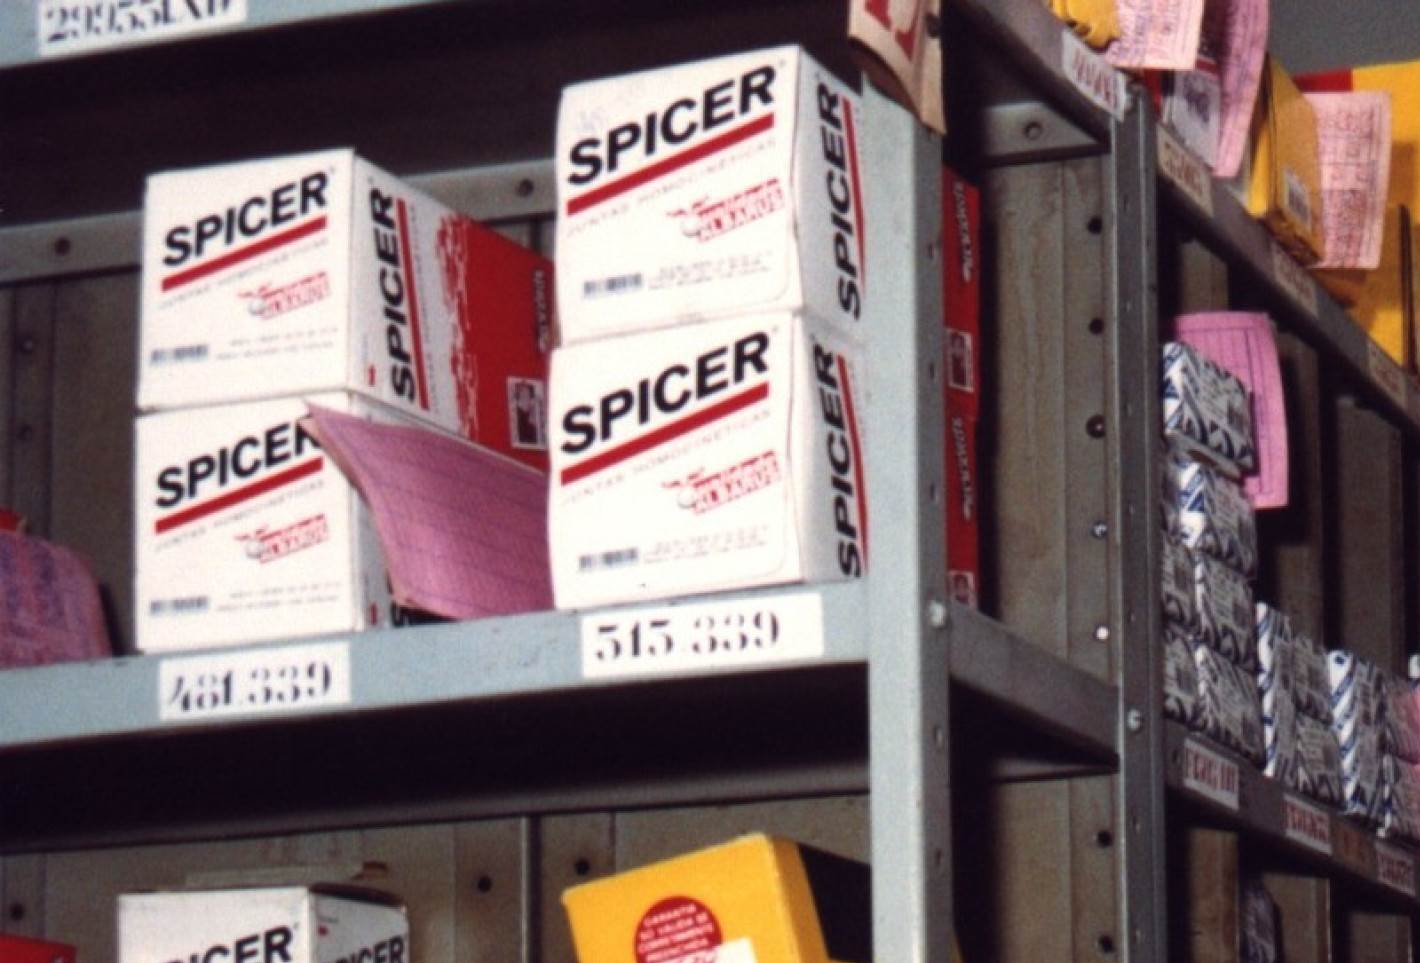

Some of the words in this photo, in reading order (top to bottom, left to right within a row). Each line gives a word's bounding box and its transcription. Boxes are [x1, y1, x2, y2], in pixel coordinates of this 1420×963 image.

[567, 65, 776, 186] SPICER
[816, 83, 861, 320] SPICER
[162, 171, 329, 267] SPICER
[369, 188, 416, 402] SPICER
[561, 332, 769, 455] SPICER
[812, 343, 862, 579] SPICER
